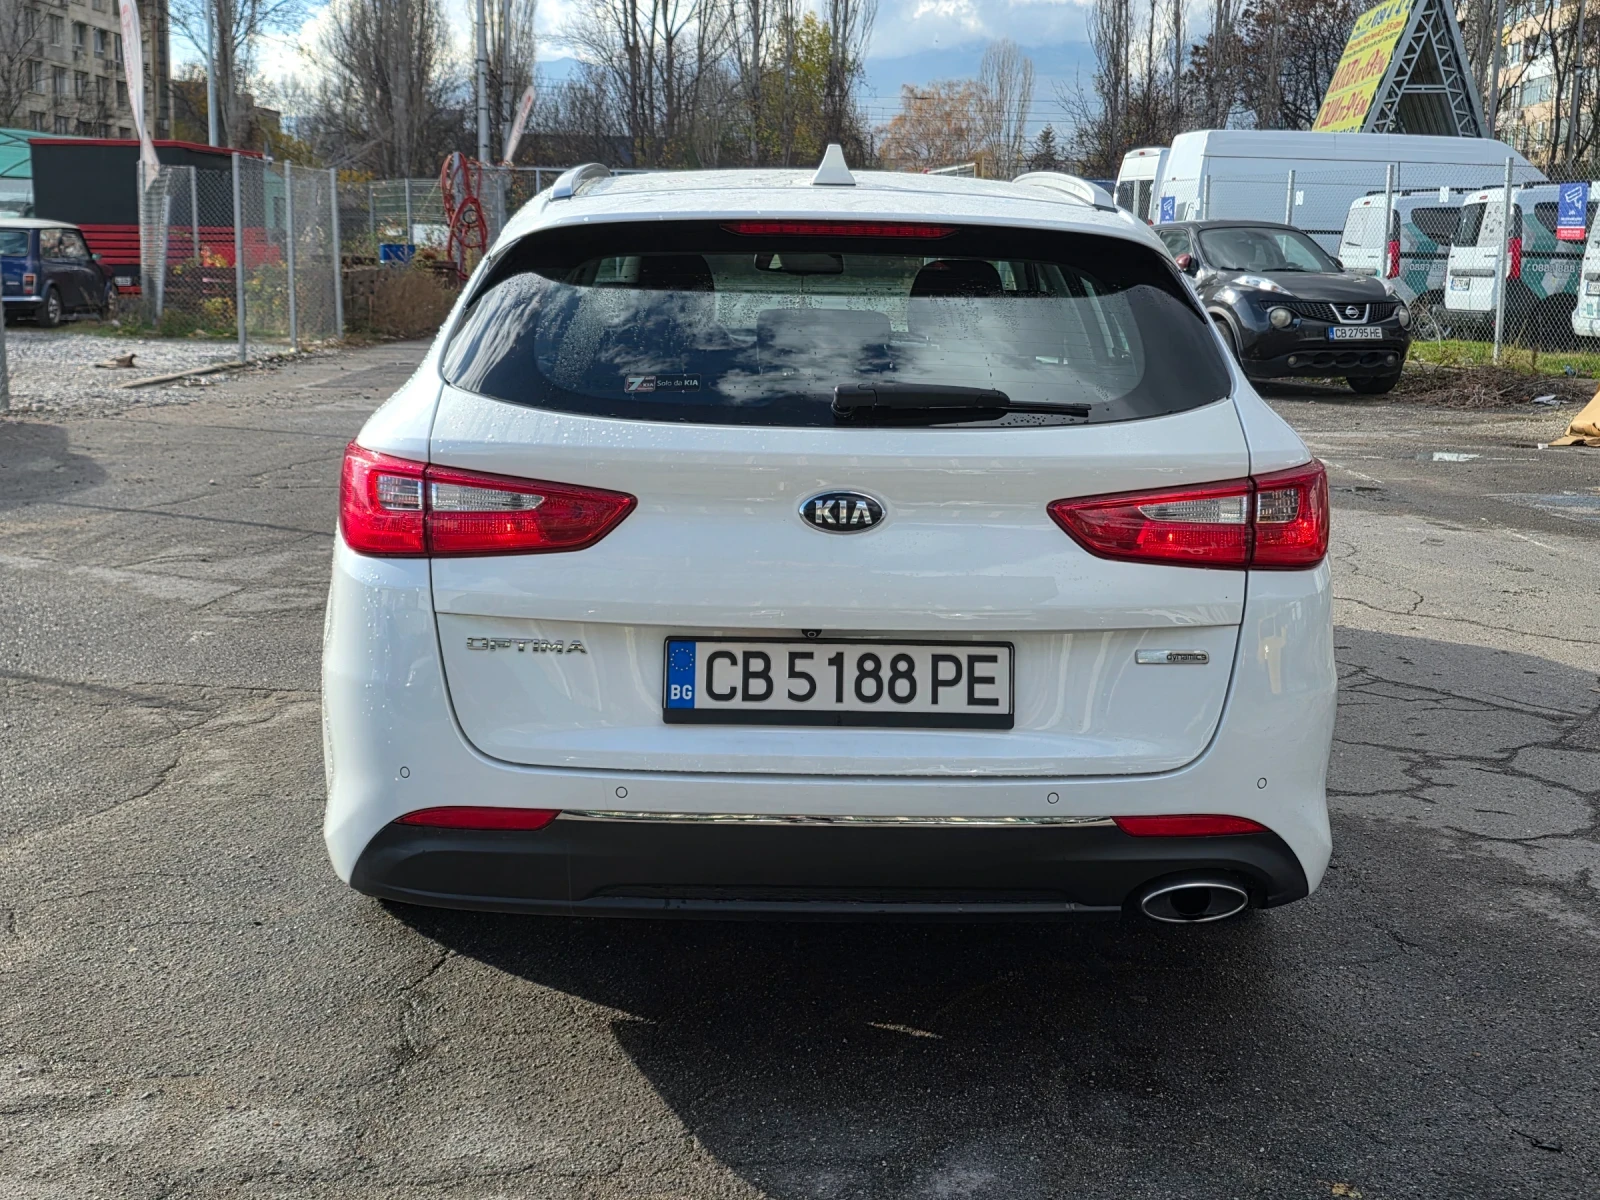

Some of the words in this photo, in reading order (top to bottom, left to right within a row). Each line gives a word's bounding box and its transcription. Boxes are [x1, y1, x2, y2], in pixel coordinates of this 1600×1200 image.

[1335, 328, 1347, 338] CB
[1348, 328, 1369, 338] 2795
[1370, 328, 1381, 338] HE
[814, 500, 873, 524] KIA
[466, 637, 588, 654] OPTIMA
[704, 650, 774, 703] CB
[786, 650, 918, 705] 5188
[930, 653, 1000, 707] PE
[670, 684, 693, 700] BG
